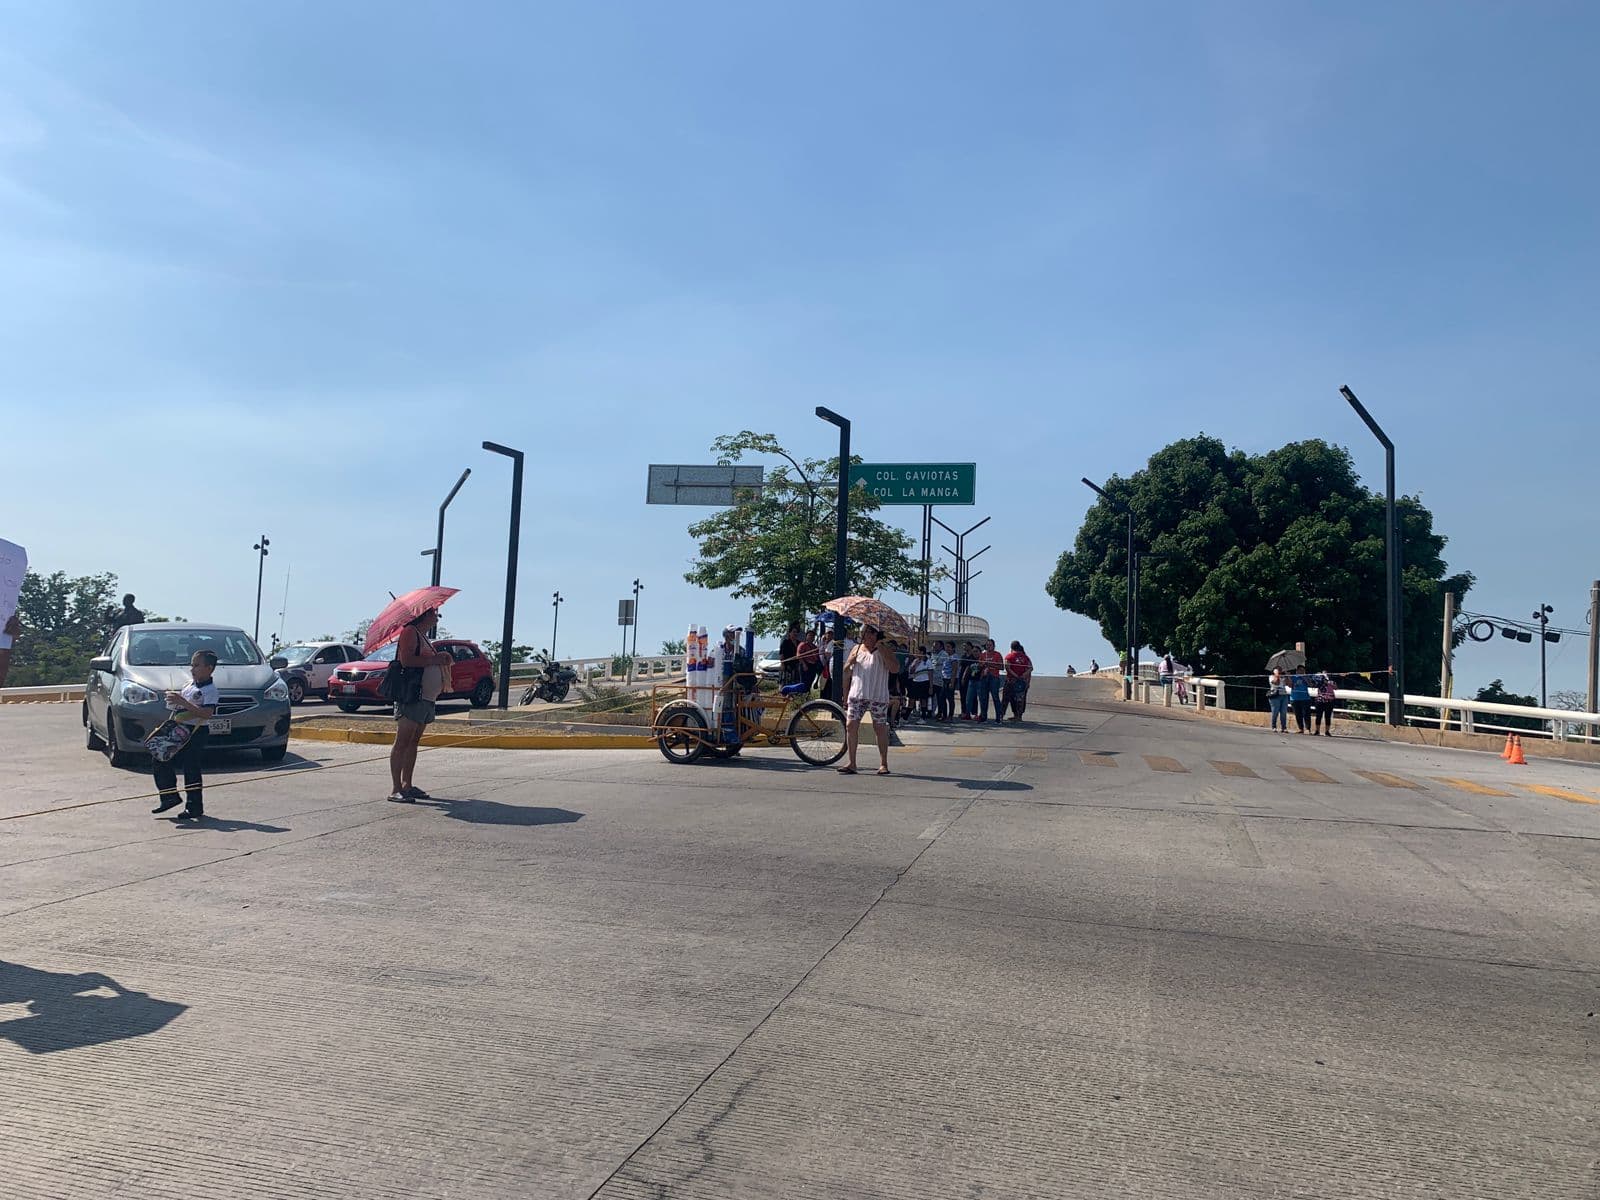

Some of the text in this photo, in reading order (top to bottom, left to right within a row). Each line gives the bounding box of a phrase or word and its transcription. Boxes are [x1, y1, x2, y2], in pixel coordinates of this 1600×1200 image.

[905, 471, 959, 481] GAVIOTAS
[902, 487, 915, 497] LA
[921, 487, 959, 497] MANGA
